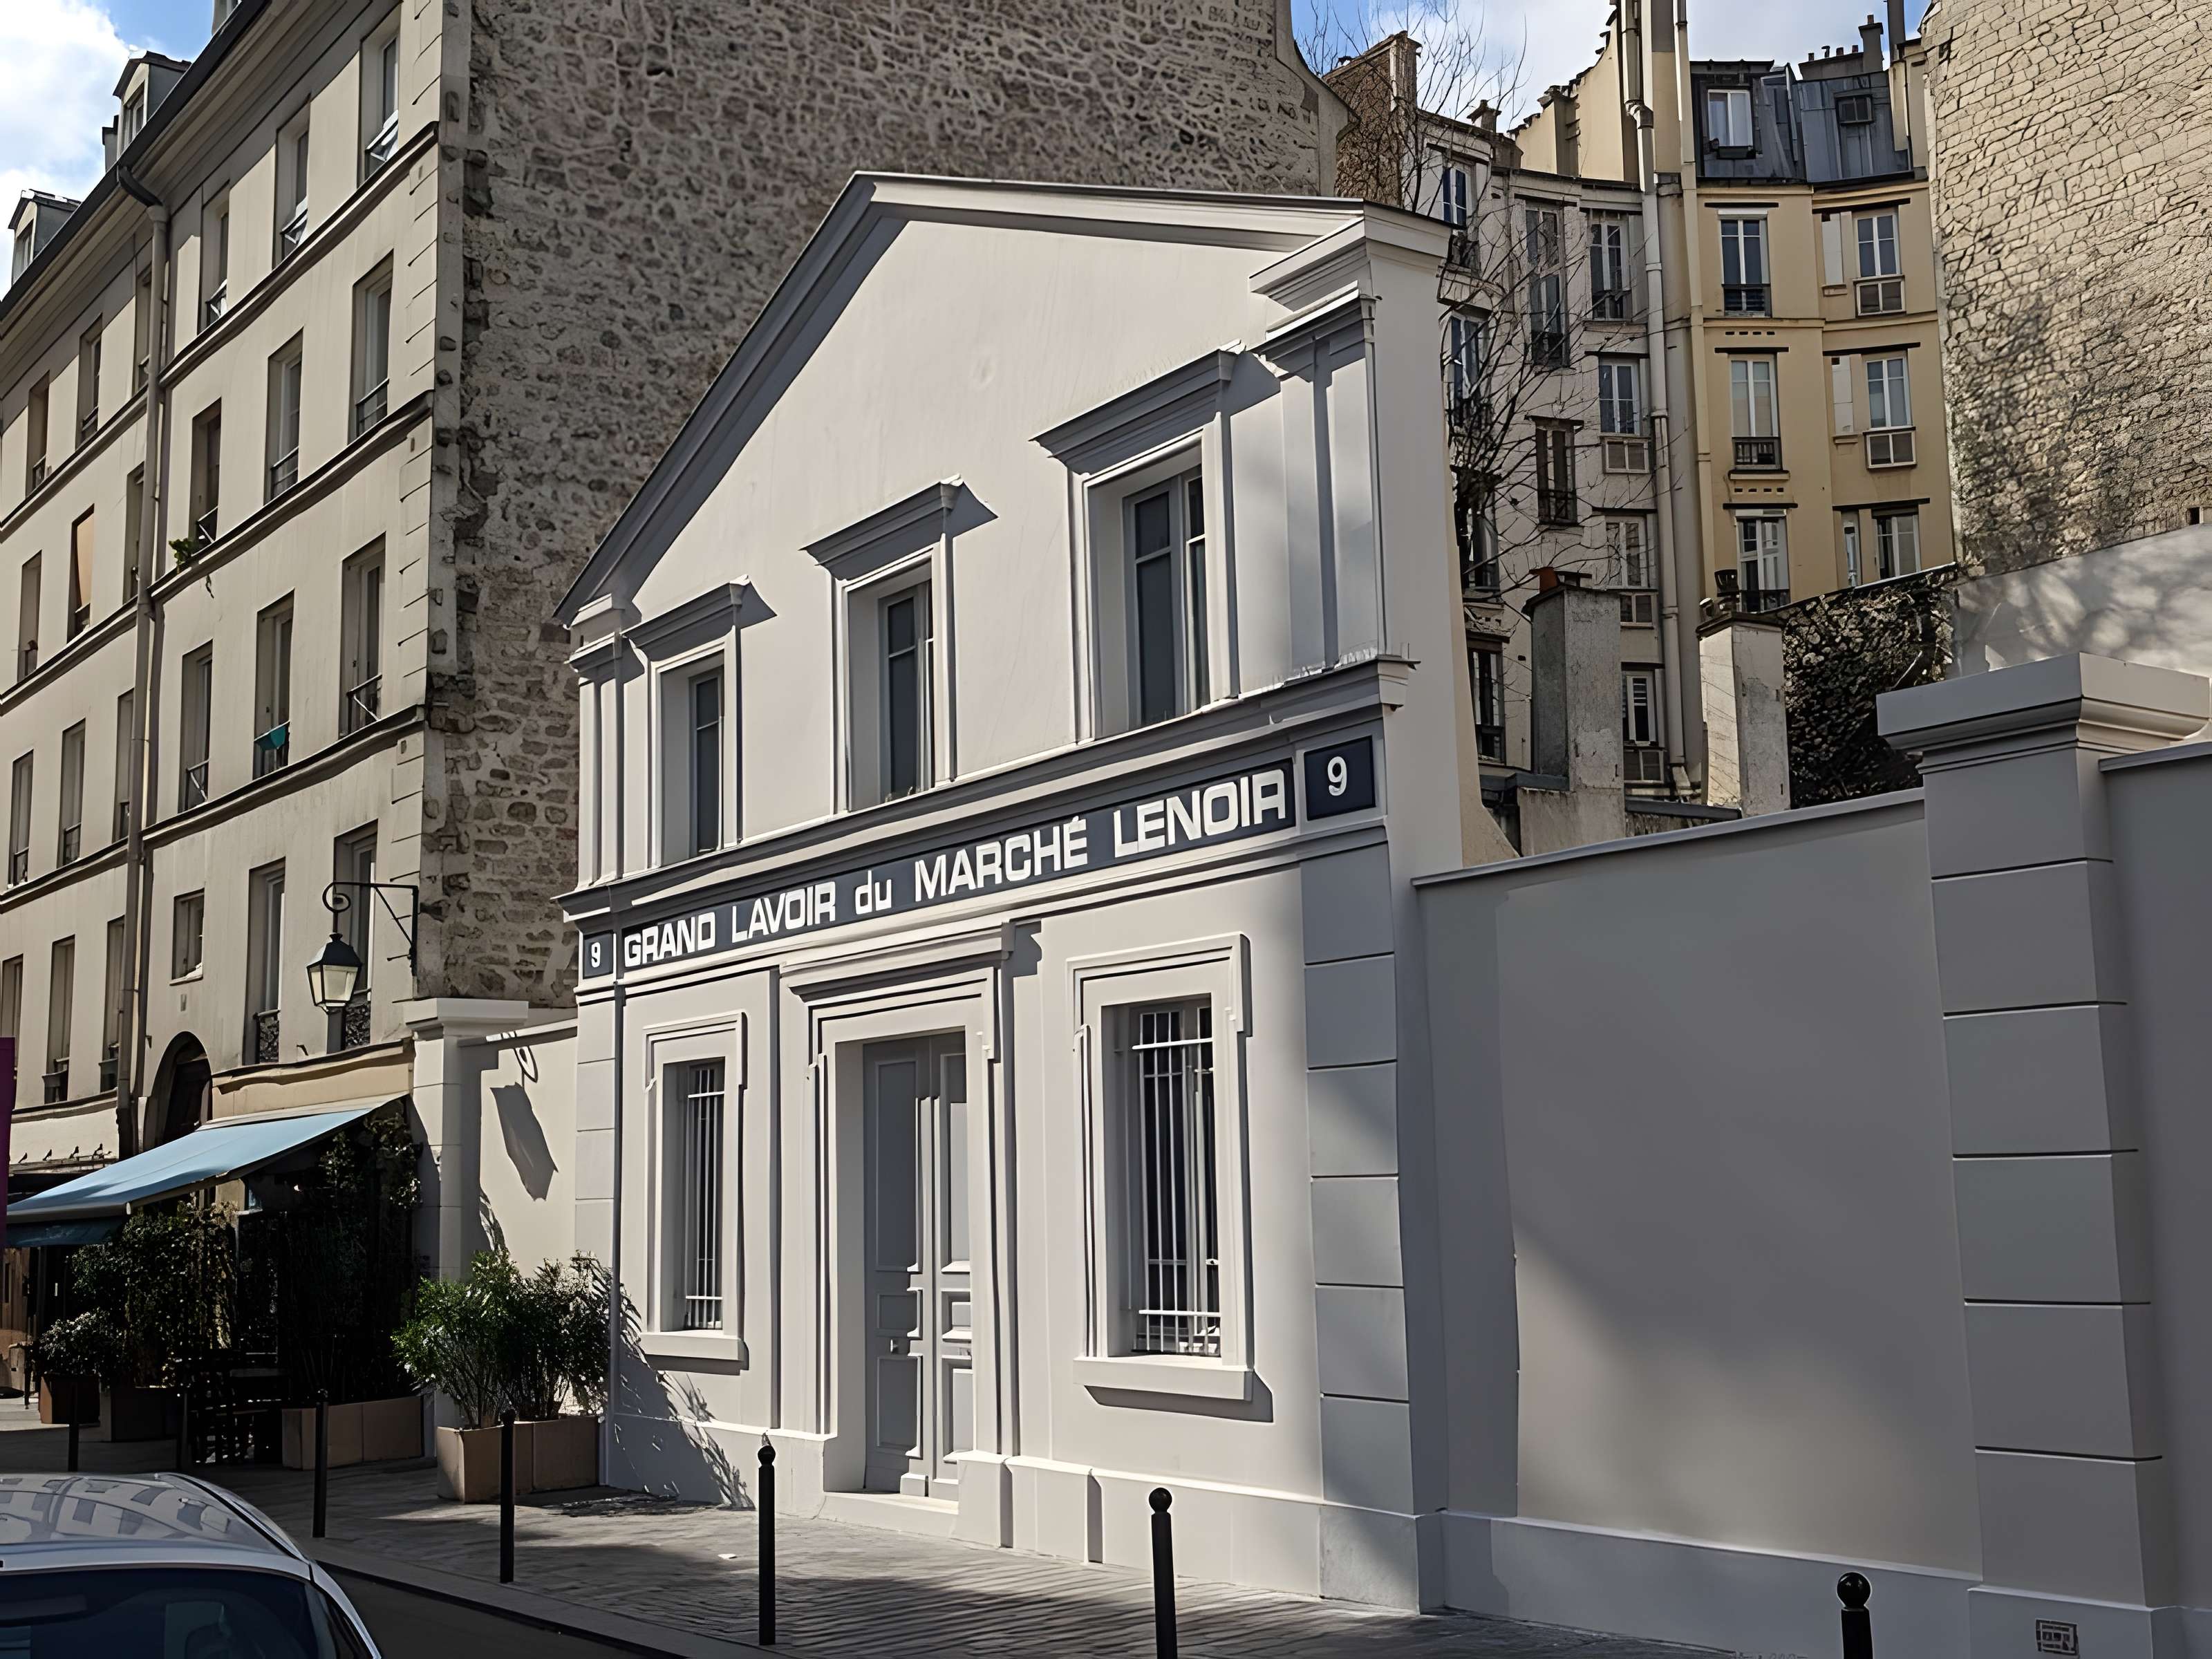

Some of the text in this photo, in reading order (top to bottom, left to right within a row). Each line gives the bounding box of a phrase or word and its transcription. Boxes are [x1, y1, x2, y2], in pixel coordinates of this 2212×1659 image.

[1327, 756, 1347, 796] 9
[624, 769, 1286, 967] GRAND LAVOIR du MARCHÉ LENOIR
[590, 941, 601, 968] 9
